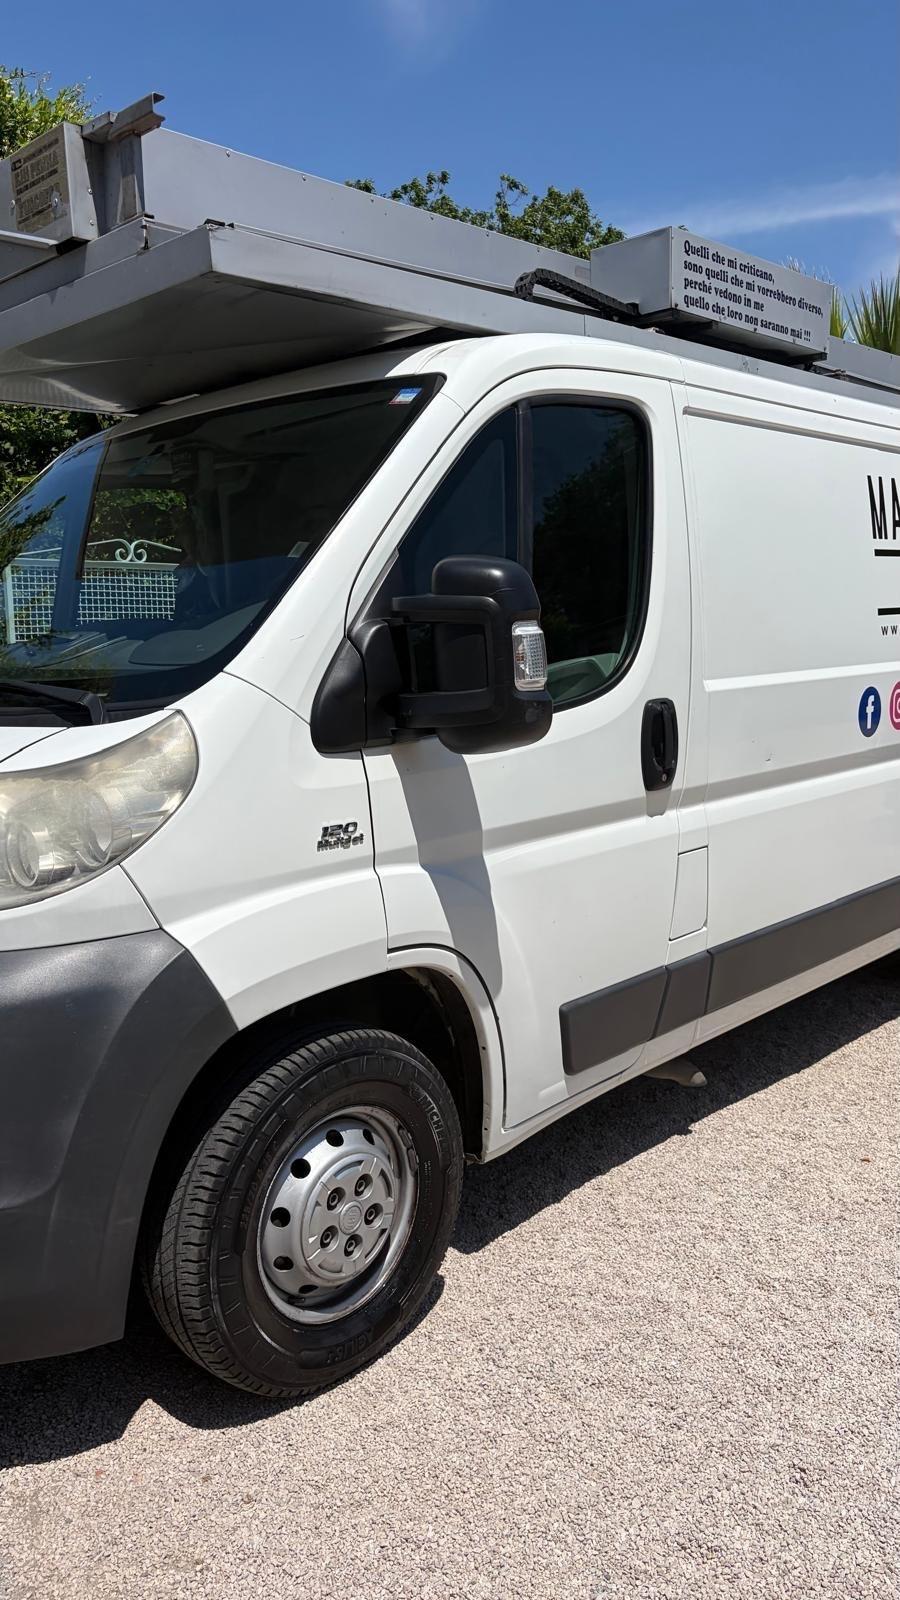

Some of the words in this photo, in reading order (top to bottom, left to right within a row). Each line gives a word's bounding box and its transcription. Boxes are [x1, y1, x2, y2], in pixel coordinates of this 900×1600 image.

[684, 240, 709, 260] Quelli
[711, 251, 726, 266] che
[727, 257, 738, 270] mi
[739, 262, 775, 285] criticano,
[684, 260, 703, 275] sono
[705, 267, 729, 284] quelli
[730, 274, 744, 289] che
[745, 280, 756, 293] mi
[757, 284, 797, 307] vorrebbero
[797, 297, 824, 318] diverso,
[684, 277, 713, 295] perché
[714, 287, 743, 305] vedono
[743, 293, 752, 308] in
[753, 300, 765, 312] me
[684, 294, 710, 311] quello
[711, 302, 726, 317] che
[727, 305, 743, 321] loro
[744, 314, 759, 327] non
[760, 319, 789, 336] saranno
[790, 328, 803, 340] mai
[321, 821, 358, 841] 120
